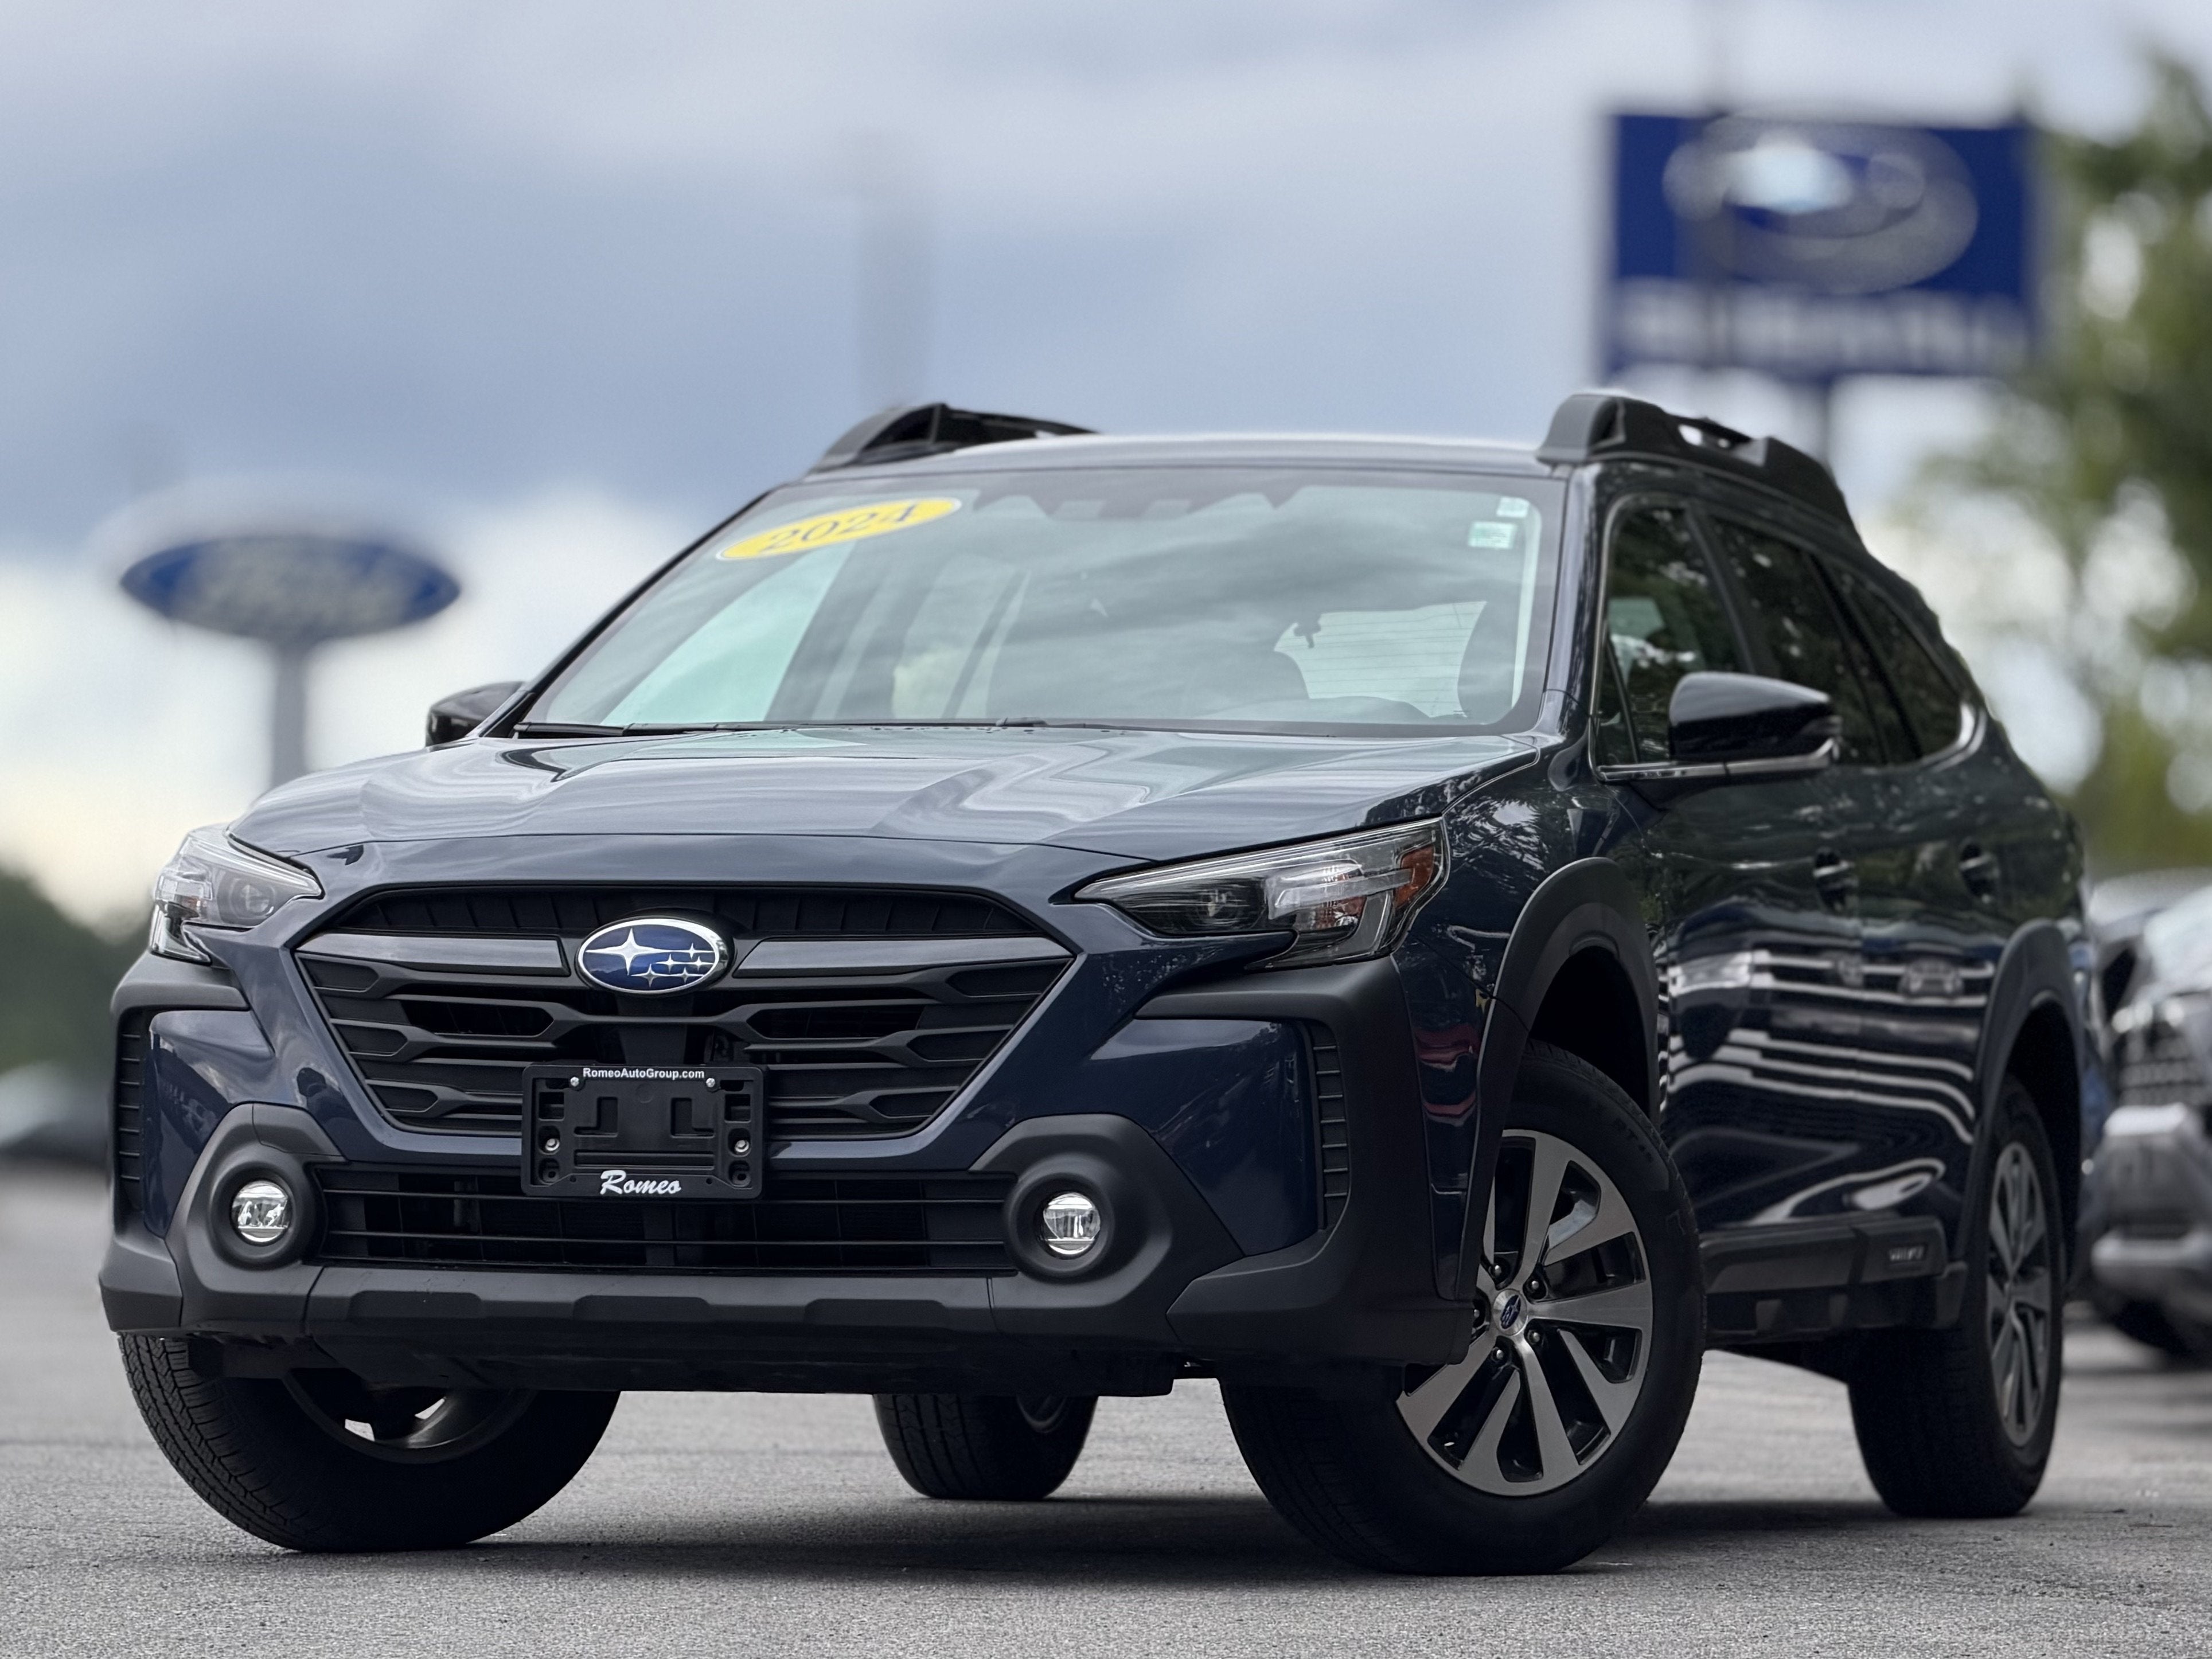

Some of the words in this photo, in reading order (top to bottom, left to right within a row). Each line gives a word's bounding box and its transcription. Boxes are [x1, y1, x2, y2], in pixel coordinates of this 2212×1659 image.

[758, 503, 918, 553] 2024
[583, 1067, 705, 1080] RomeoAutoGroup.com
[600, 1169, 681, 1195] Romeo
